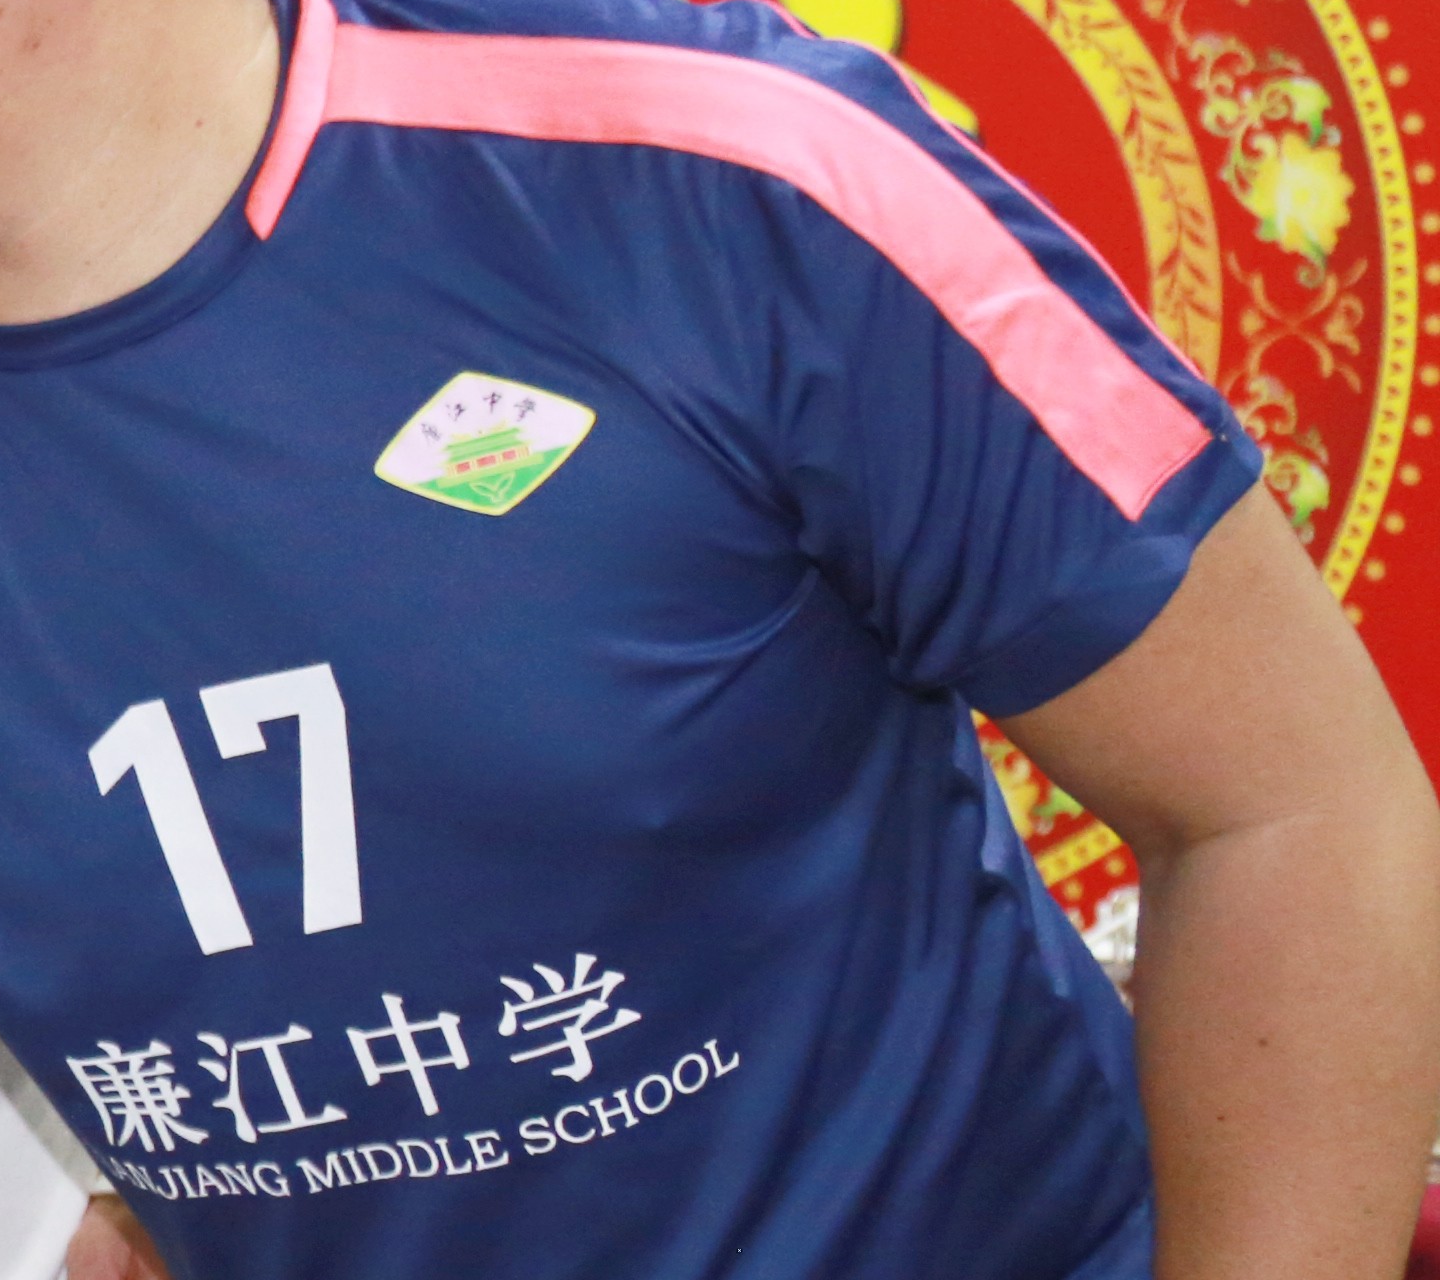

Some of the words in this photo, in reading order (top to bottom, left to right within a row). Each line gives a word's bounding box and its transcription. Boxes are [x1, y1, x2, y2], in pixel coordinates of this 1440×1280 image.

[87, 663, 363, 956] 17
[64, 952, 642, 1152] 廉江中学
[295, 1129, 510, 1195] MIDDLE
[518, 1038, 741, 1157] SCHOOL
